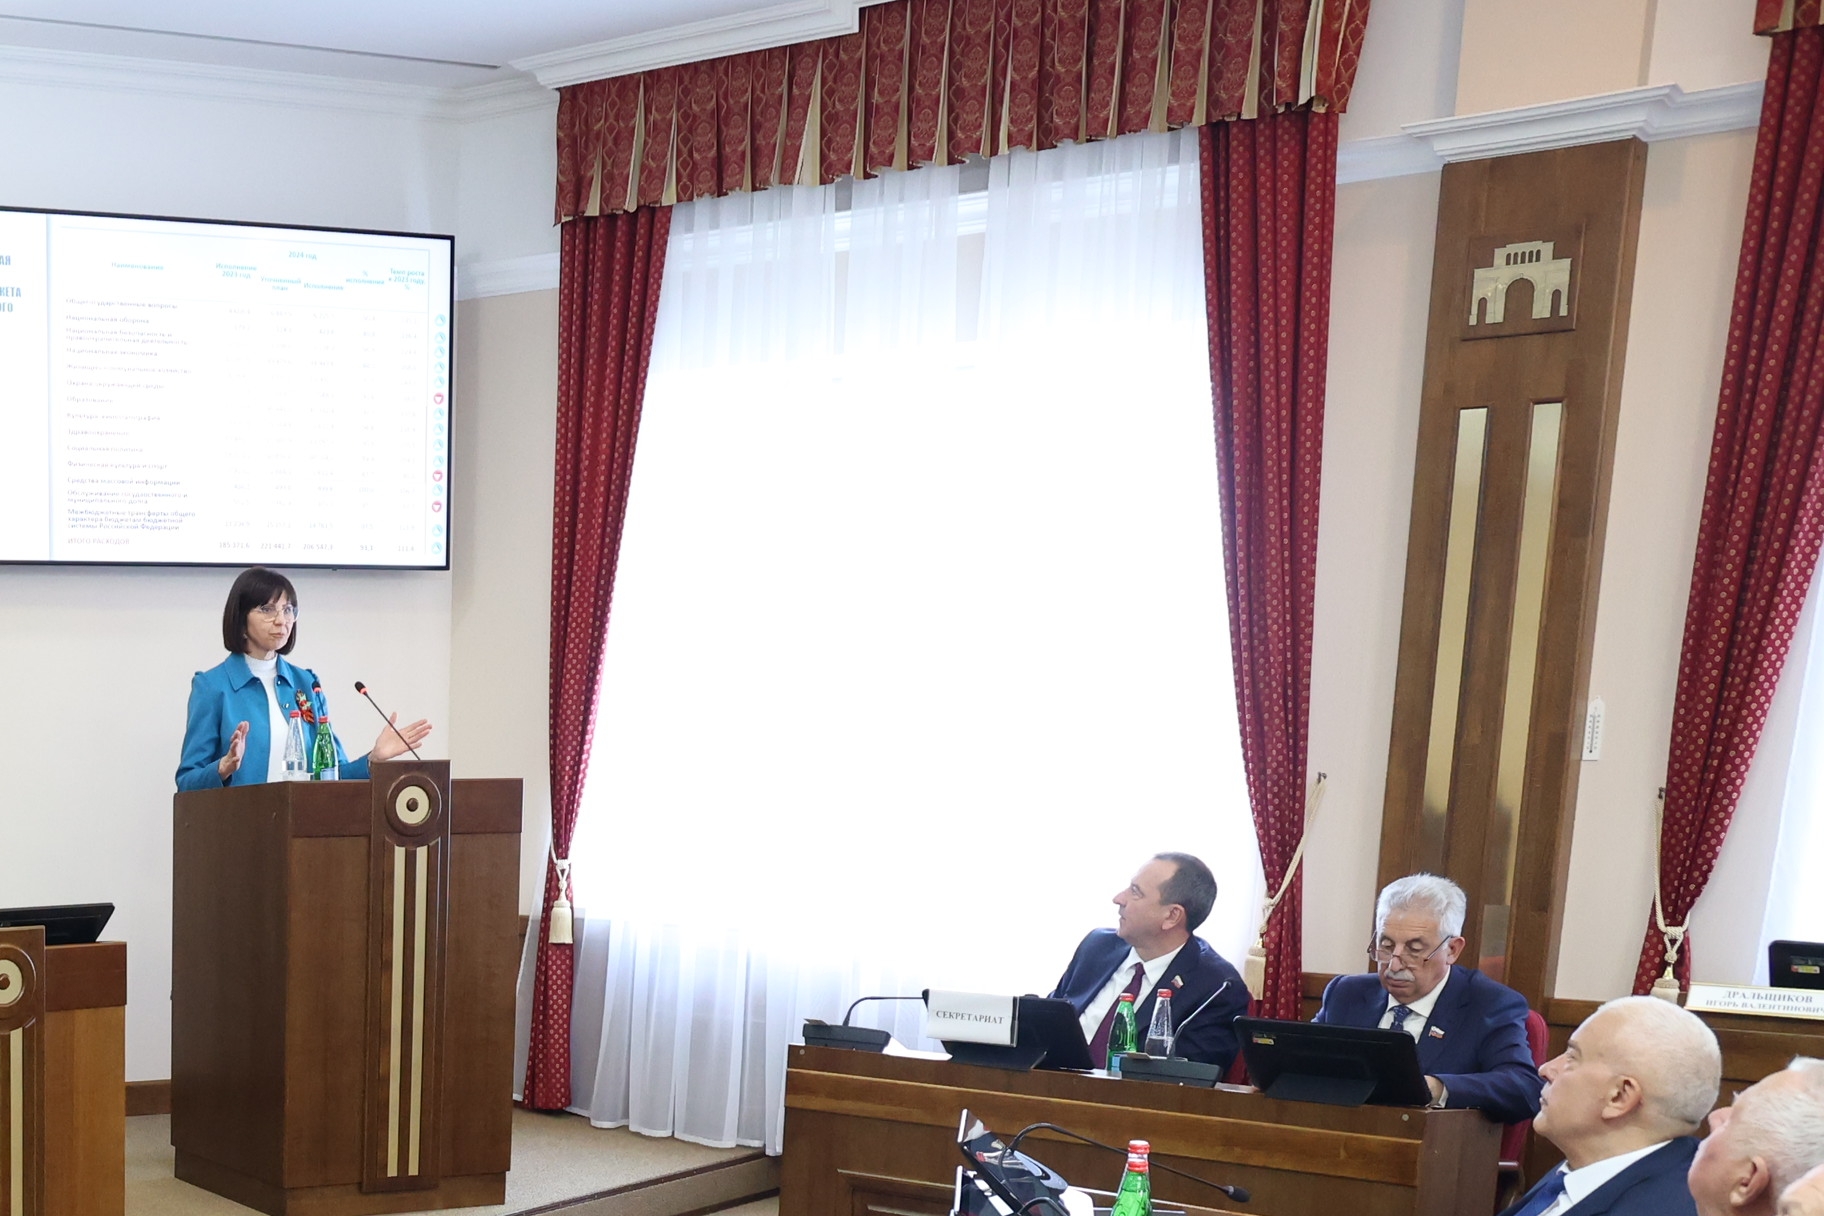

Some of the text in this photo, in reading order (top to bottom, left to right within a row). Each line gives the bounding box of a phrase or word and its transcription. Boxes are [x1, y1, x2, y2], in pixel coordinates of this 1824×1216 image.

[1705, 999, 1739, 1008] ИГОРЬ
[1722, 990, 1814, 1004] ДРАЛЬЩИКОВ
[935, 1010, 1005, 1024] СЕКРЕТАРИАТ
